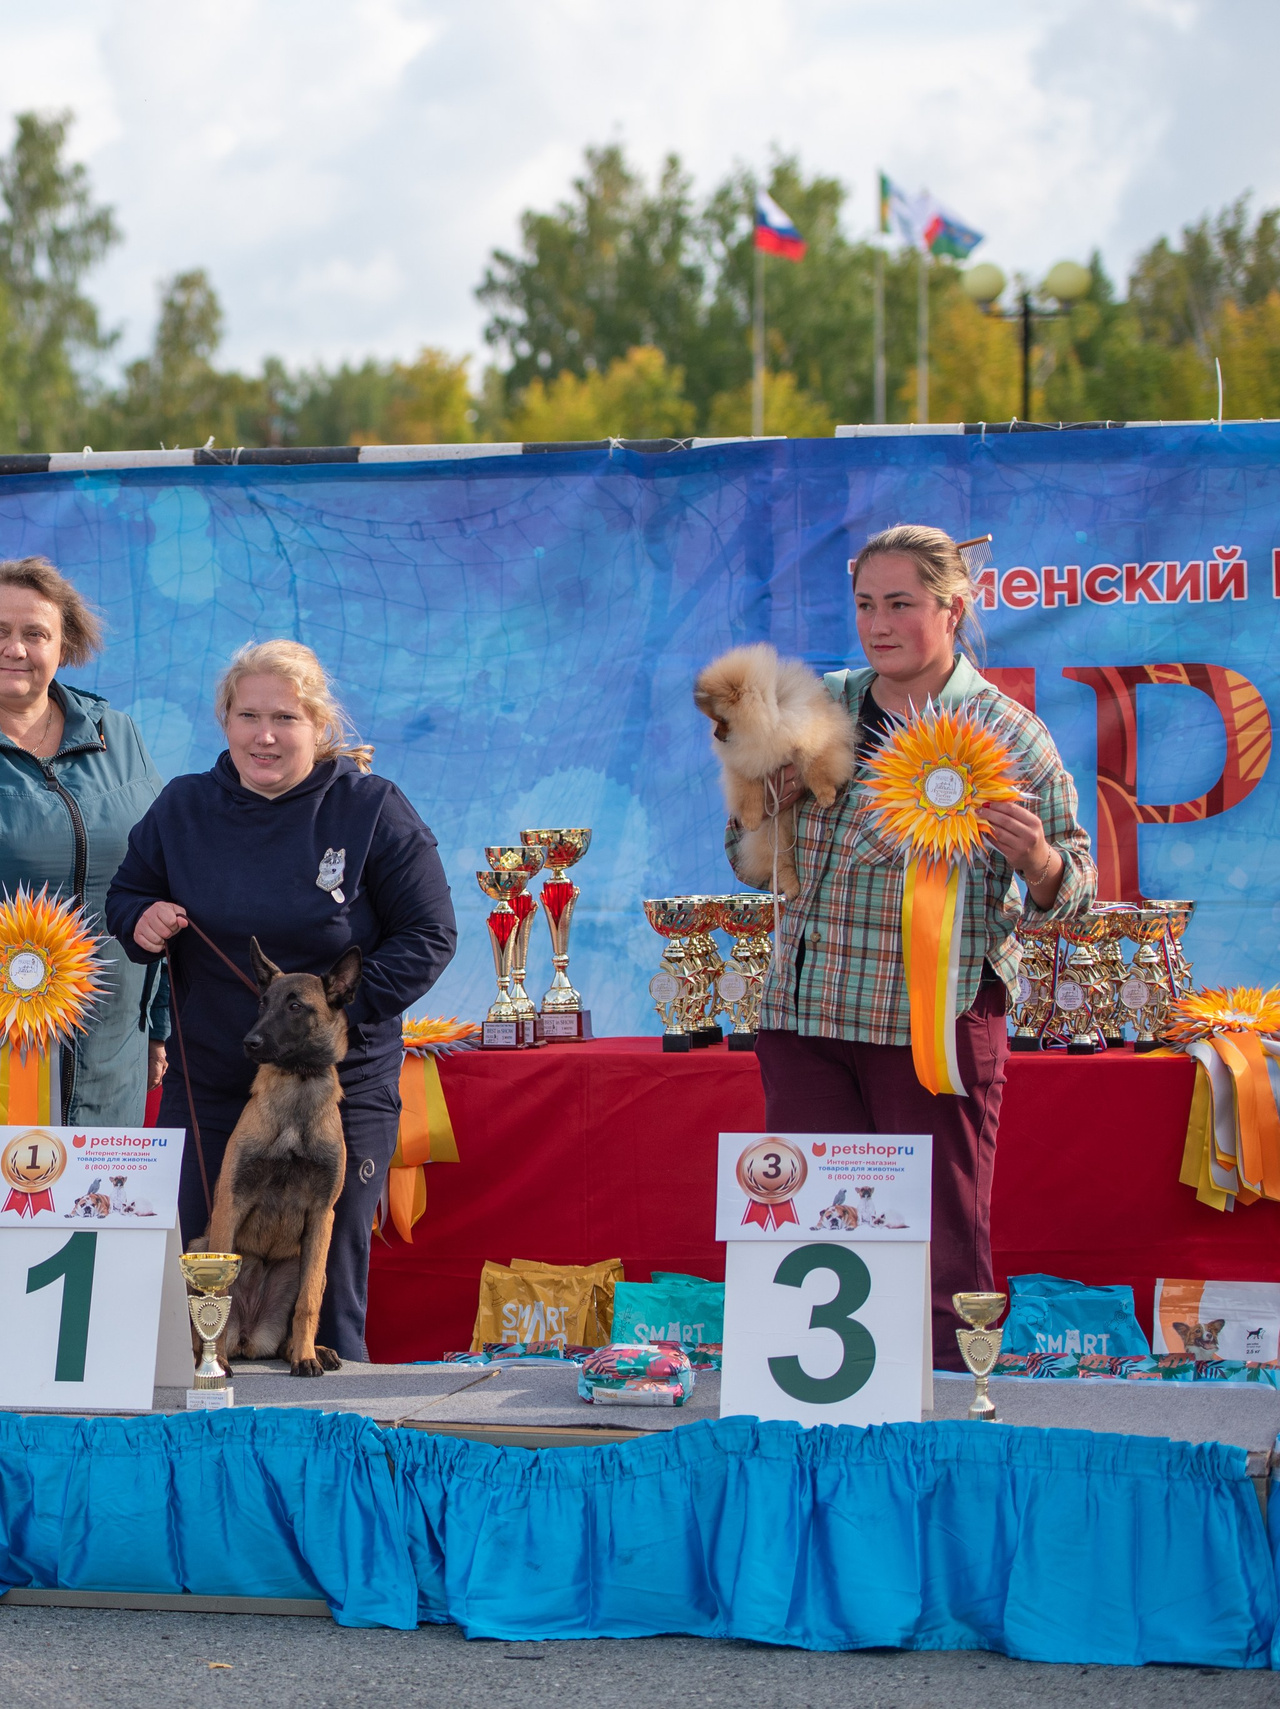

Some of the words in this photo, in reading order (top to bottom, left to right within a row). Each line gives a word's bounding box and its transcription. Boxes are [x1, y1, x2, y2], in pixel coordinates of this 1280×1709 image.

[848, 545, 1248, 613] менский
[90, 1135, 168, 1149] petshopru
[831, 1142, 914, 1158] petshopru
[26, 1144, 41, 1170] 1
[762, 1153, 782, 1179] 3
[834, 1173, 855, 1181] (800)
[25, 1231, 98, 1383] 1
[502, 1300, 569, 1332] SMART
[633, 1321, 705, 1345] SMART
[767, 1242, 877, 1405] 3
[1035, 1329, 1111, 1356] SMART
